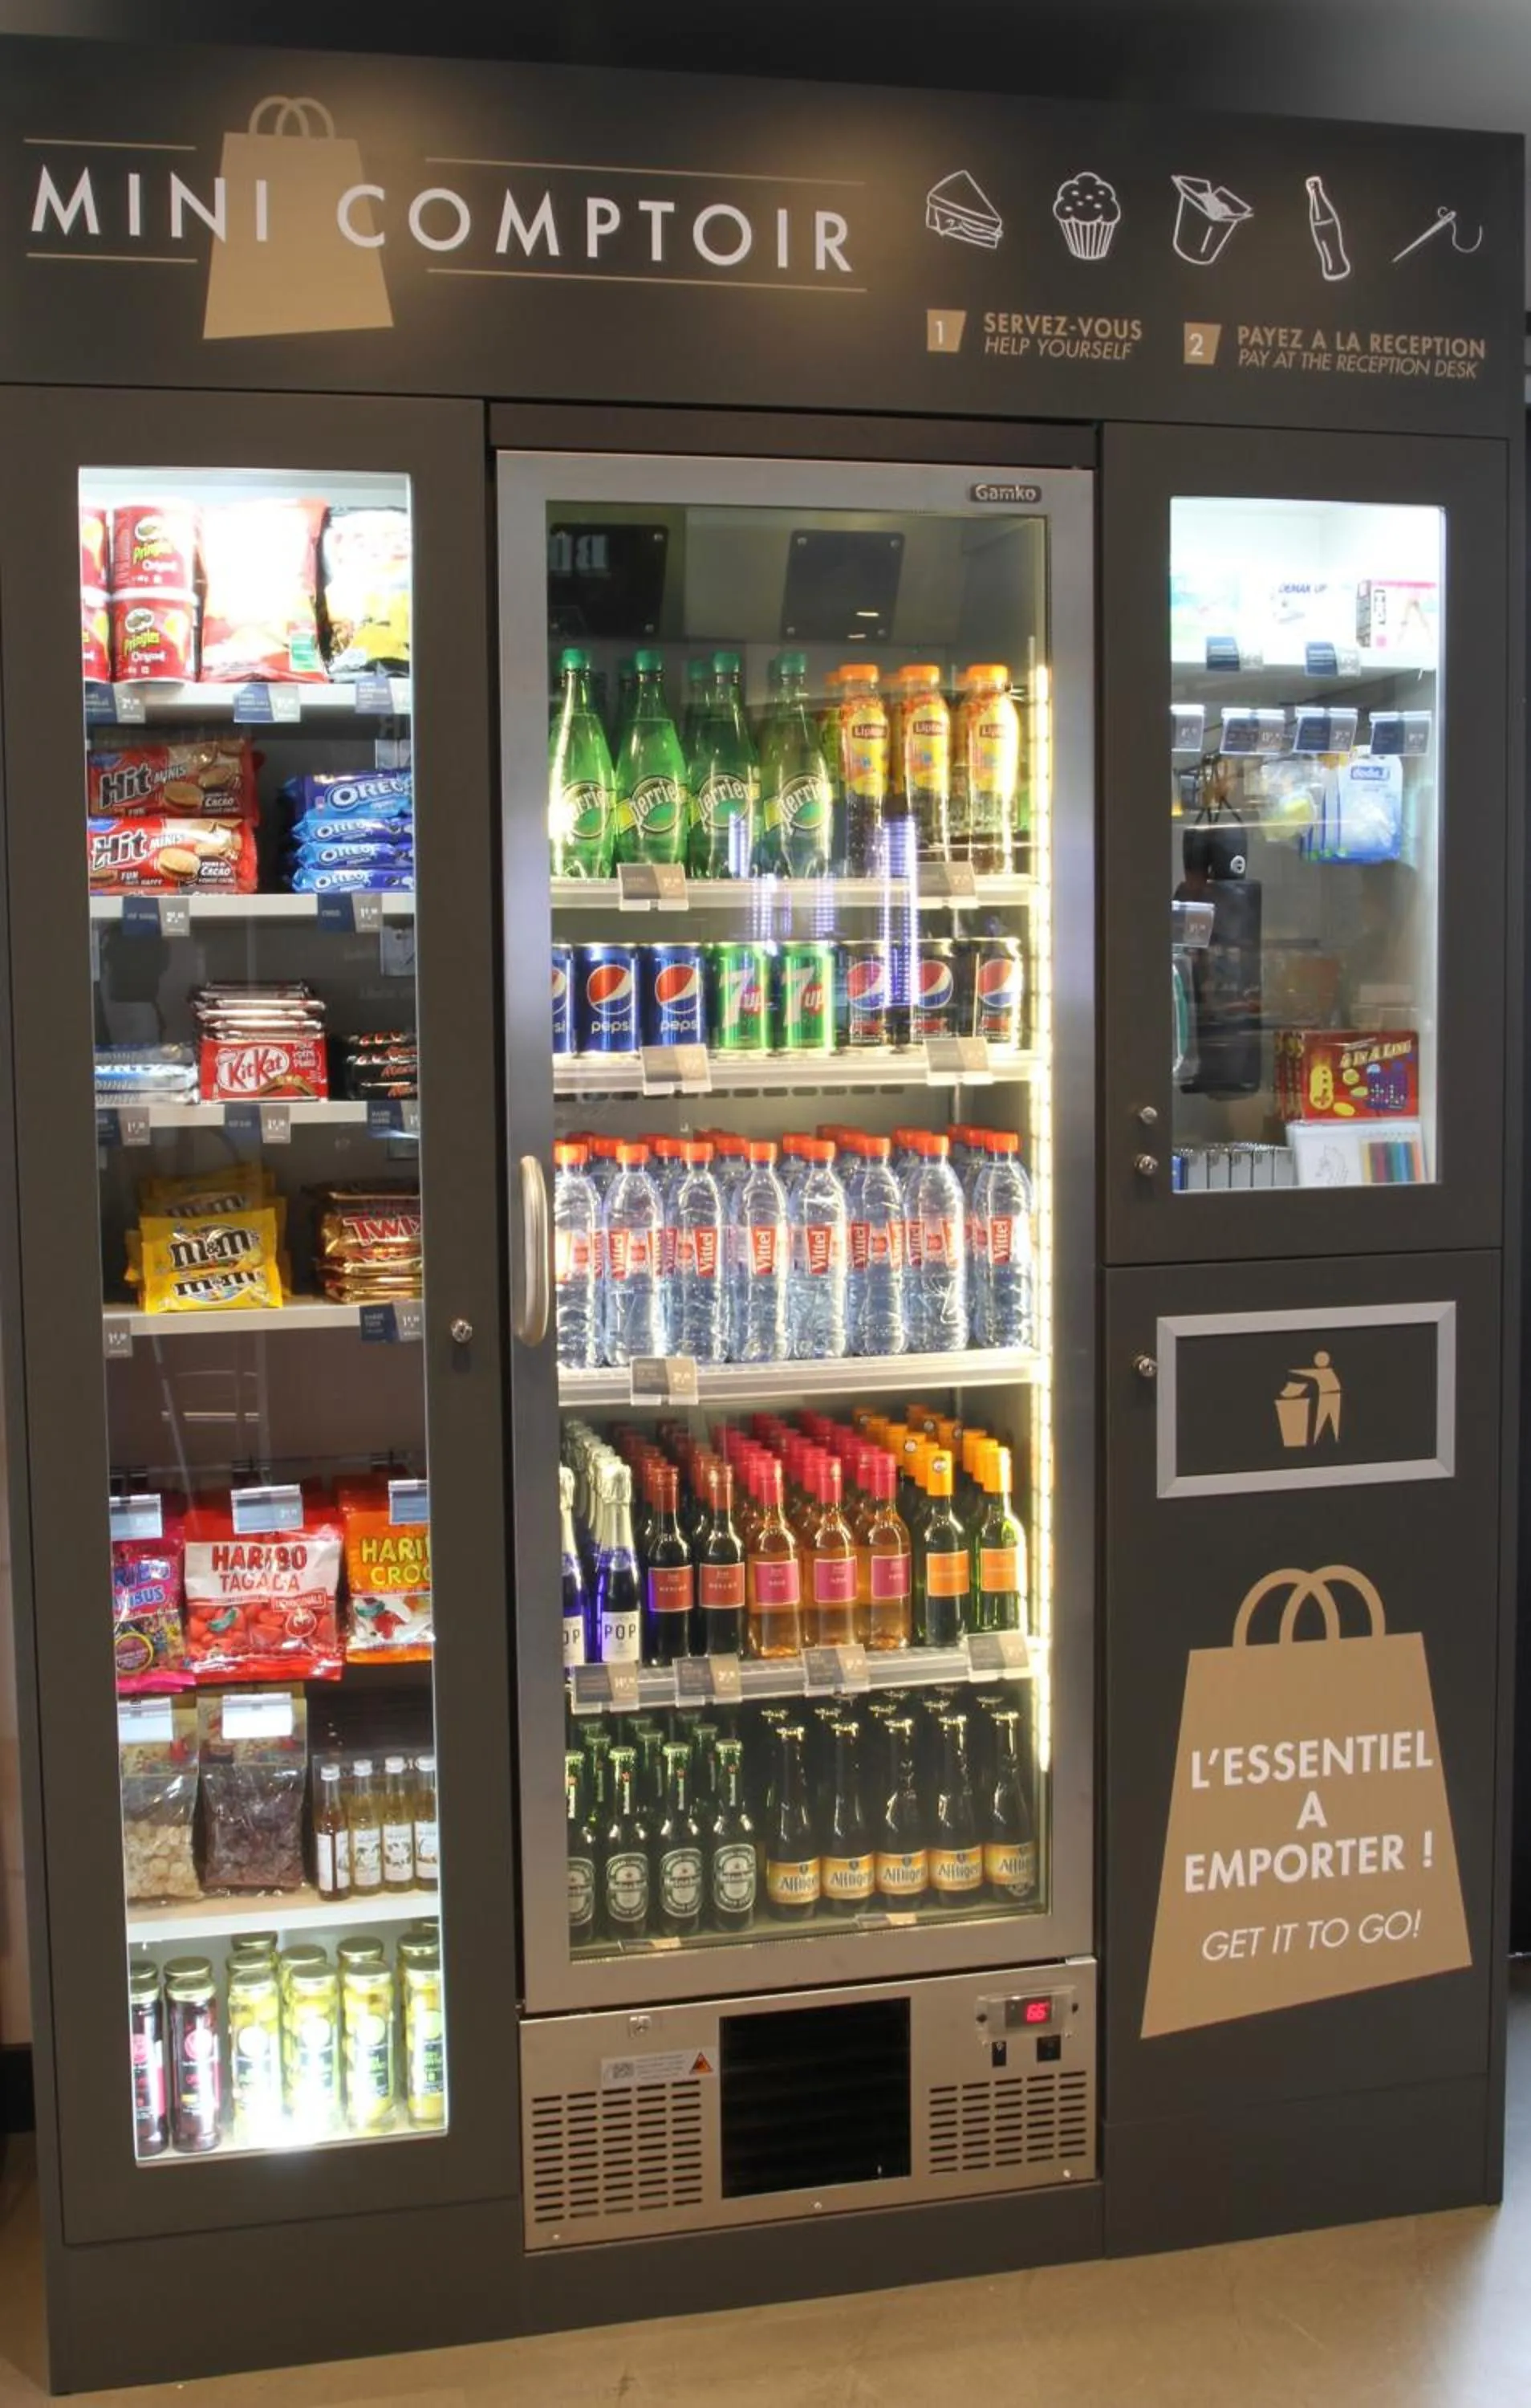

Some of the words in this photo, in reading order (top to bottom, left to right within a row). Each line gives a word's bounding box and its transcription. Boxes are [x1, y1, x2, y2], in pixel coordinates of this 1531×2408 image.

[30, 165, 268, 242] MINI
[336, 183, 853, 274] COMPTOIR
[935, 320, 944, 344] 1
[983, 311, 1143, 340] SERVEZ-VOUS
[1188, 332, 1204, 356] 2
[1237, 325, 1303, 349] PAYEZ
[1311, 332, 1327, 351] A
[1336, 332, 1361, 352] LA
[1370, 333, 1486, 360] RECEPTION
[984, 336, 1030, 356] HELP
[1037, 338, 1133, 360] YOURSELF
[1238, 348, 1267, 368] PAY
[1273, 349, 1296, 368] AT
[1300, 351, 1333, 372] THE
[1336, 352, 1431, 376] RECEPTION
[1434, 360, 1480, 379] DESK
[975, 484, 1037, 501] Gamko
[100, 762, 152, 809] Hit
[91, 828, 148, 871] Hit
[660, 1019, 699, 1032] peps
[228, 1047, 284, 1090] KitKat
[699, 1232, 714, 1272] Vittel
[756, 1230, 772, 1270] Vittel
[810, 1230, 826, 1270] Vittel
[211, 1544, 308, 1572] HARIBO
[362, 1536, 430, 1564] HARI
[604, 1623, 636, 1641] POP
[1191, 1730, 1435, 1789] L'ESSENTIEL
[1295, 1791, 1328, 1831] A
[1184, 1833, 1406, 1893] EMPORTER
[1423, 1830, 1434, 1868] !
[1202, 1926, 1265, 1961] GET
[1272, 1923, 1299, 1954] IT
[1306, 1917, 1350, 1950] TO
[1358, 1908, 1423, 1943] GO!
